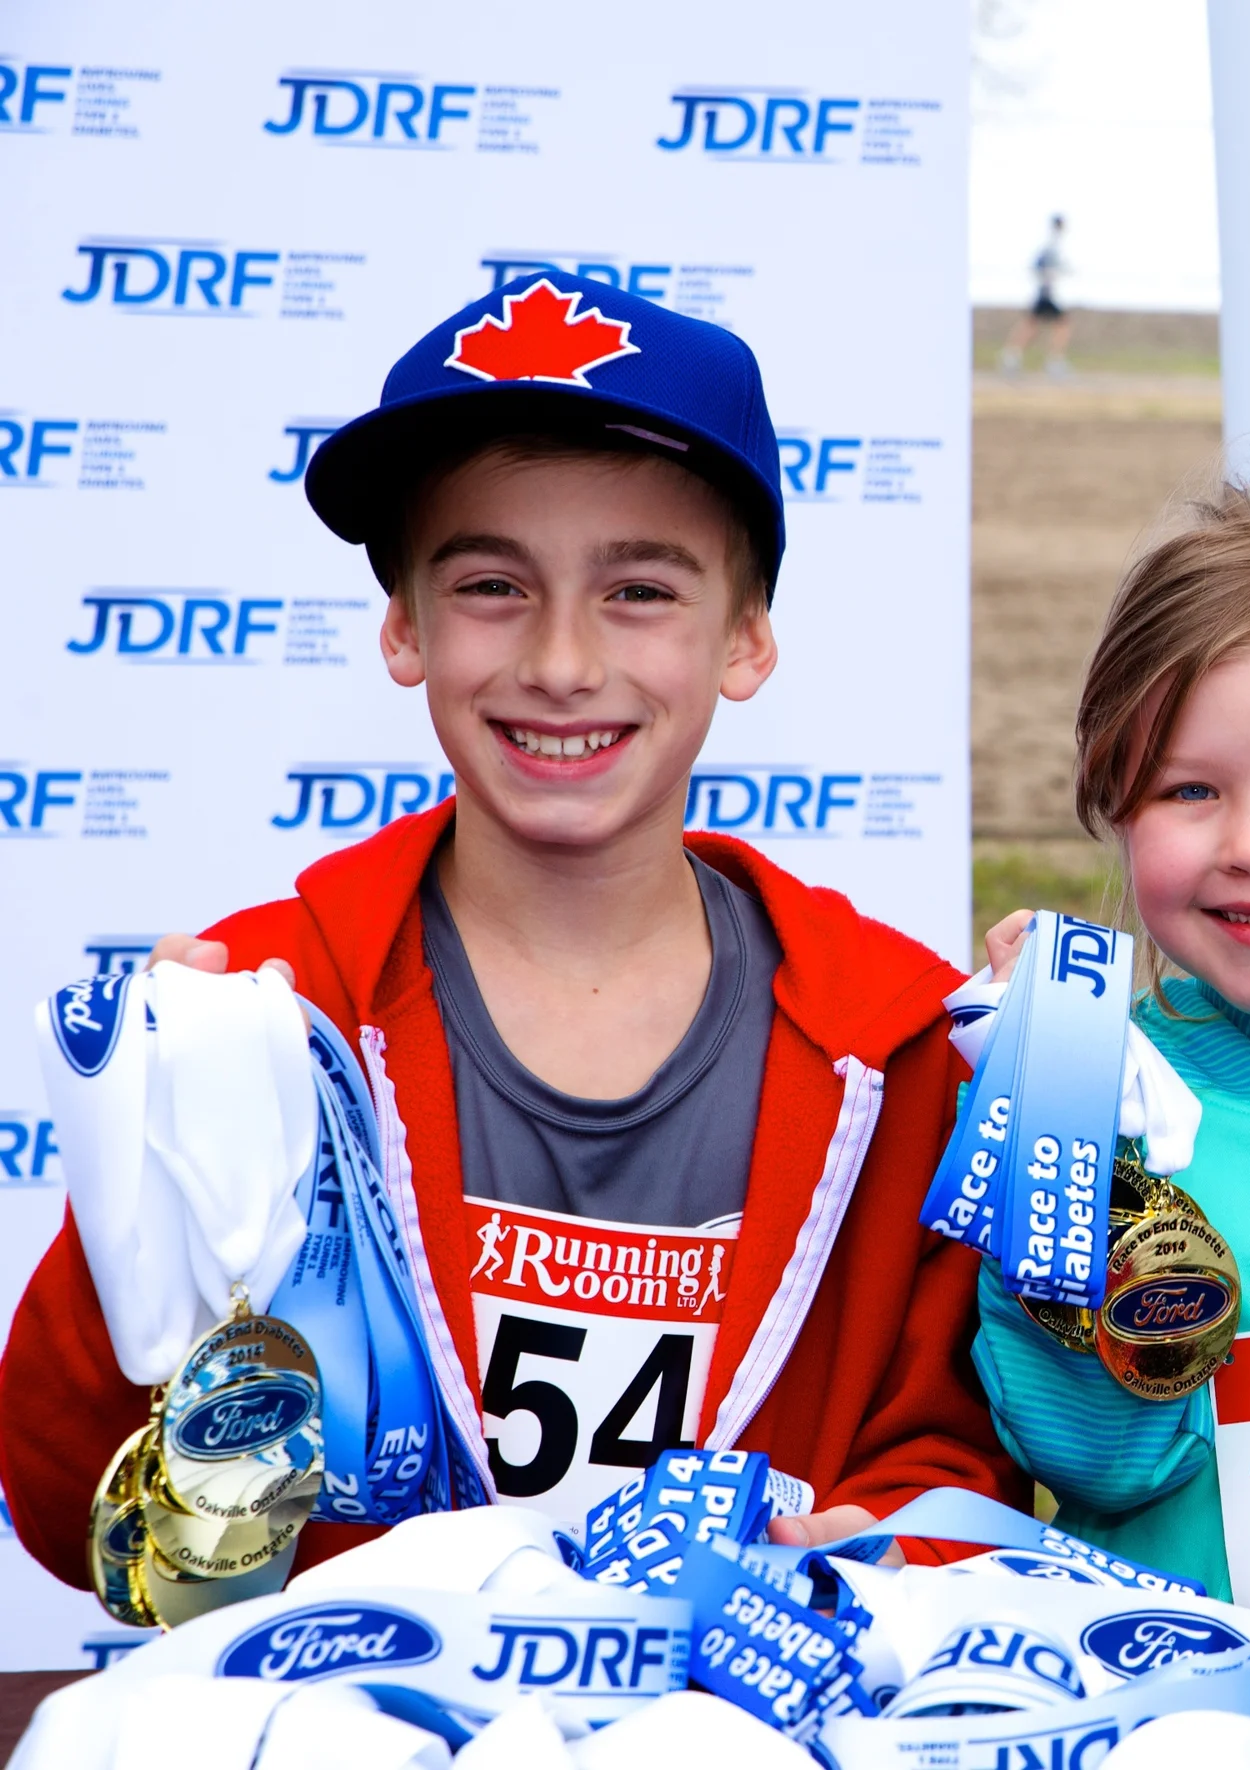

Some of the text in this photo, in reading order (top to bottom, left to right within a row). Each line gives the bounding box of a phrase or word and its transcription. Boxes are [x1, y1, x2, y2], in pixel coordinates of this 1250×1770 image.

[263, 78, 477, 141] JDRF
[657, 94, 860, 154] JDRF
[62, 245, 280, 308] JDRF
[66, 597, 283, 655] JDRF
[978, 1097, 1011, 1142] to
[1028, 1135, 1061, 1180] to
[1016, 1190, 1056, 1281] Race
[1053, 1139, 1100, 1292] iabetes
[504, 1224, 705, 1297] Running
[1111, 1218, 1226, 1273] Race to End Diabetes
[1154, 1240, 1187, 1257] 2014
[1134, 1287, 1206, 1327] Ford
[225, 1321, 253, 1340] End
[255, 1319, 306, 1359] Diabetes
[1123, 1356, 1218, 1396] Oakville Ontario
[204, 1395, 284, 1447] Ford
[481, 1313, 696, 1498] 54
[195, 1468, 298, 1518] Oakville Ontario
[178, 1524, 295, 1572] Oakville Ontario
[260, 1613, 398, 1681] Ford
[472, 1623, 668, 1688] JDRF
[699, 1628, 737, 1669] to
[729, 1647, 808, 1722] Race
